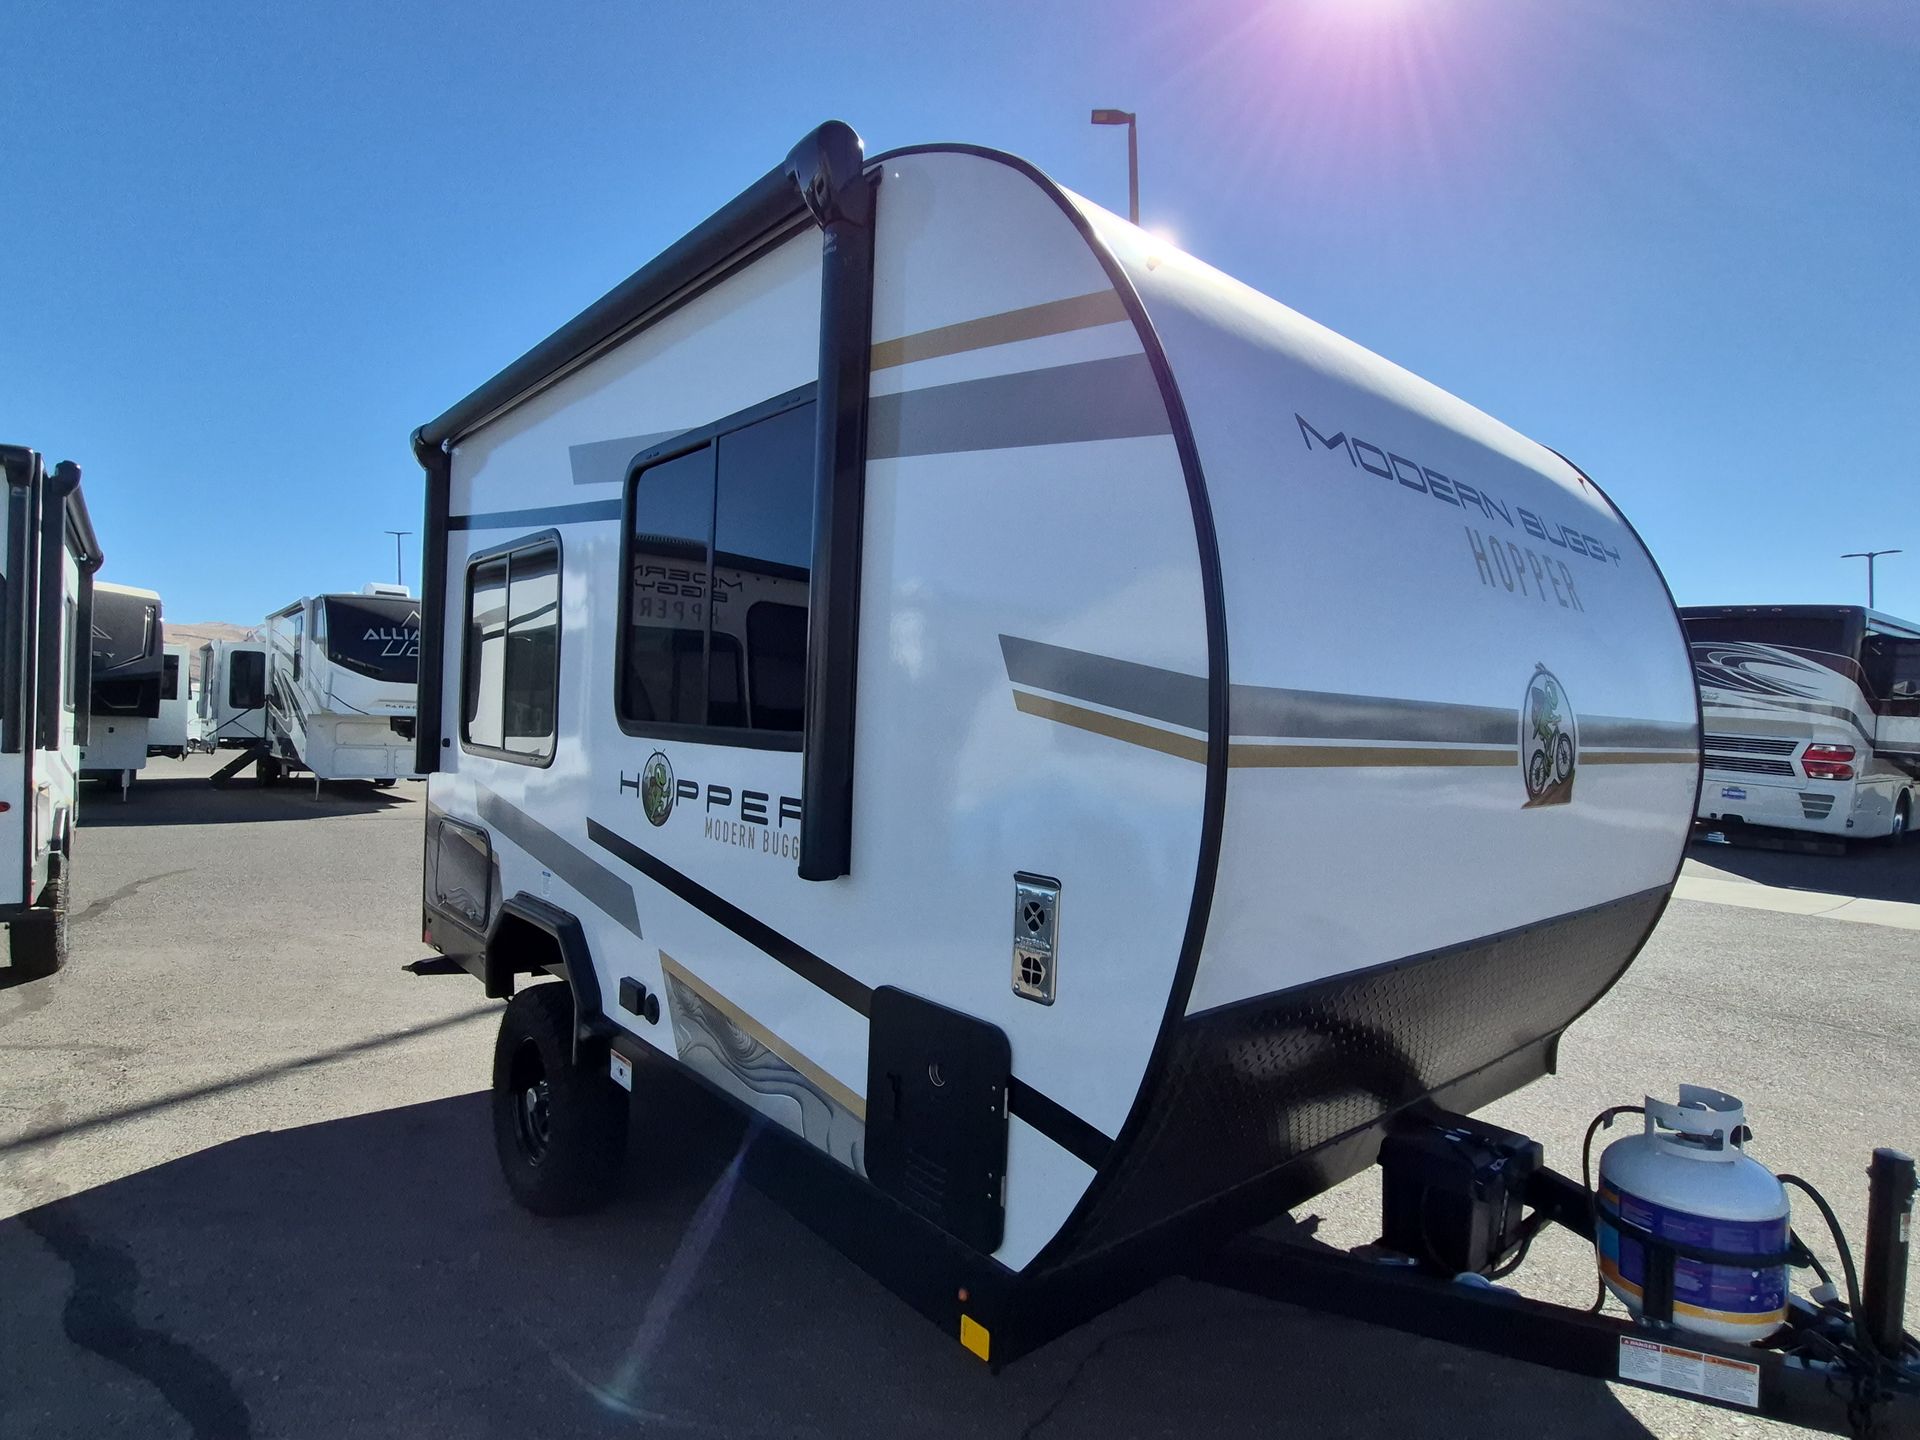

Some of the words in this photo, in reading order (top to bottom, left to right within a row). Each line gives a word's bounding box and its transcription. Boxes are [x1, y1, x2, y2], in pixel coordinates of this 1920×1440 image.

[1294, 412, 1515, 528] MODERN
[1516, 506, 1622, 568] BUGGY
[1464, 525, 1585, 613] HOPPER
[704, 816, 755, 850] MODERN
